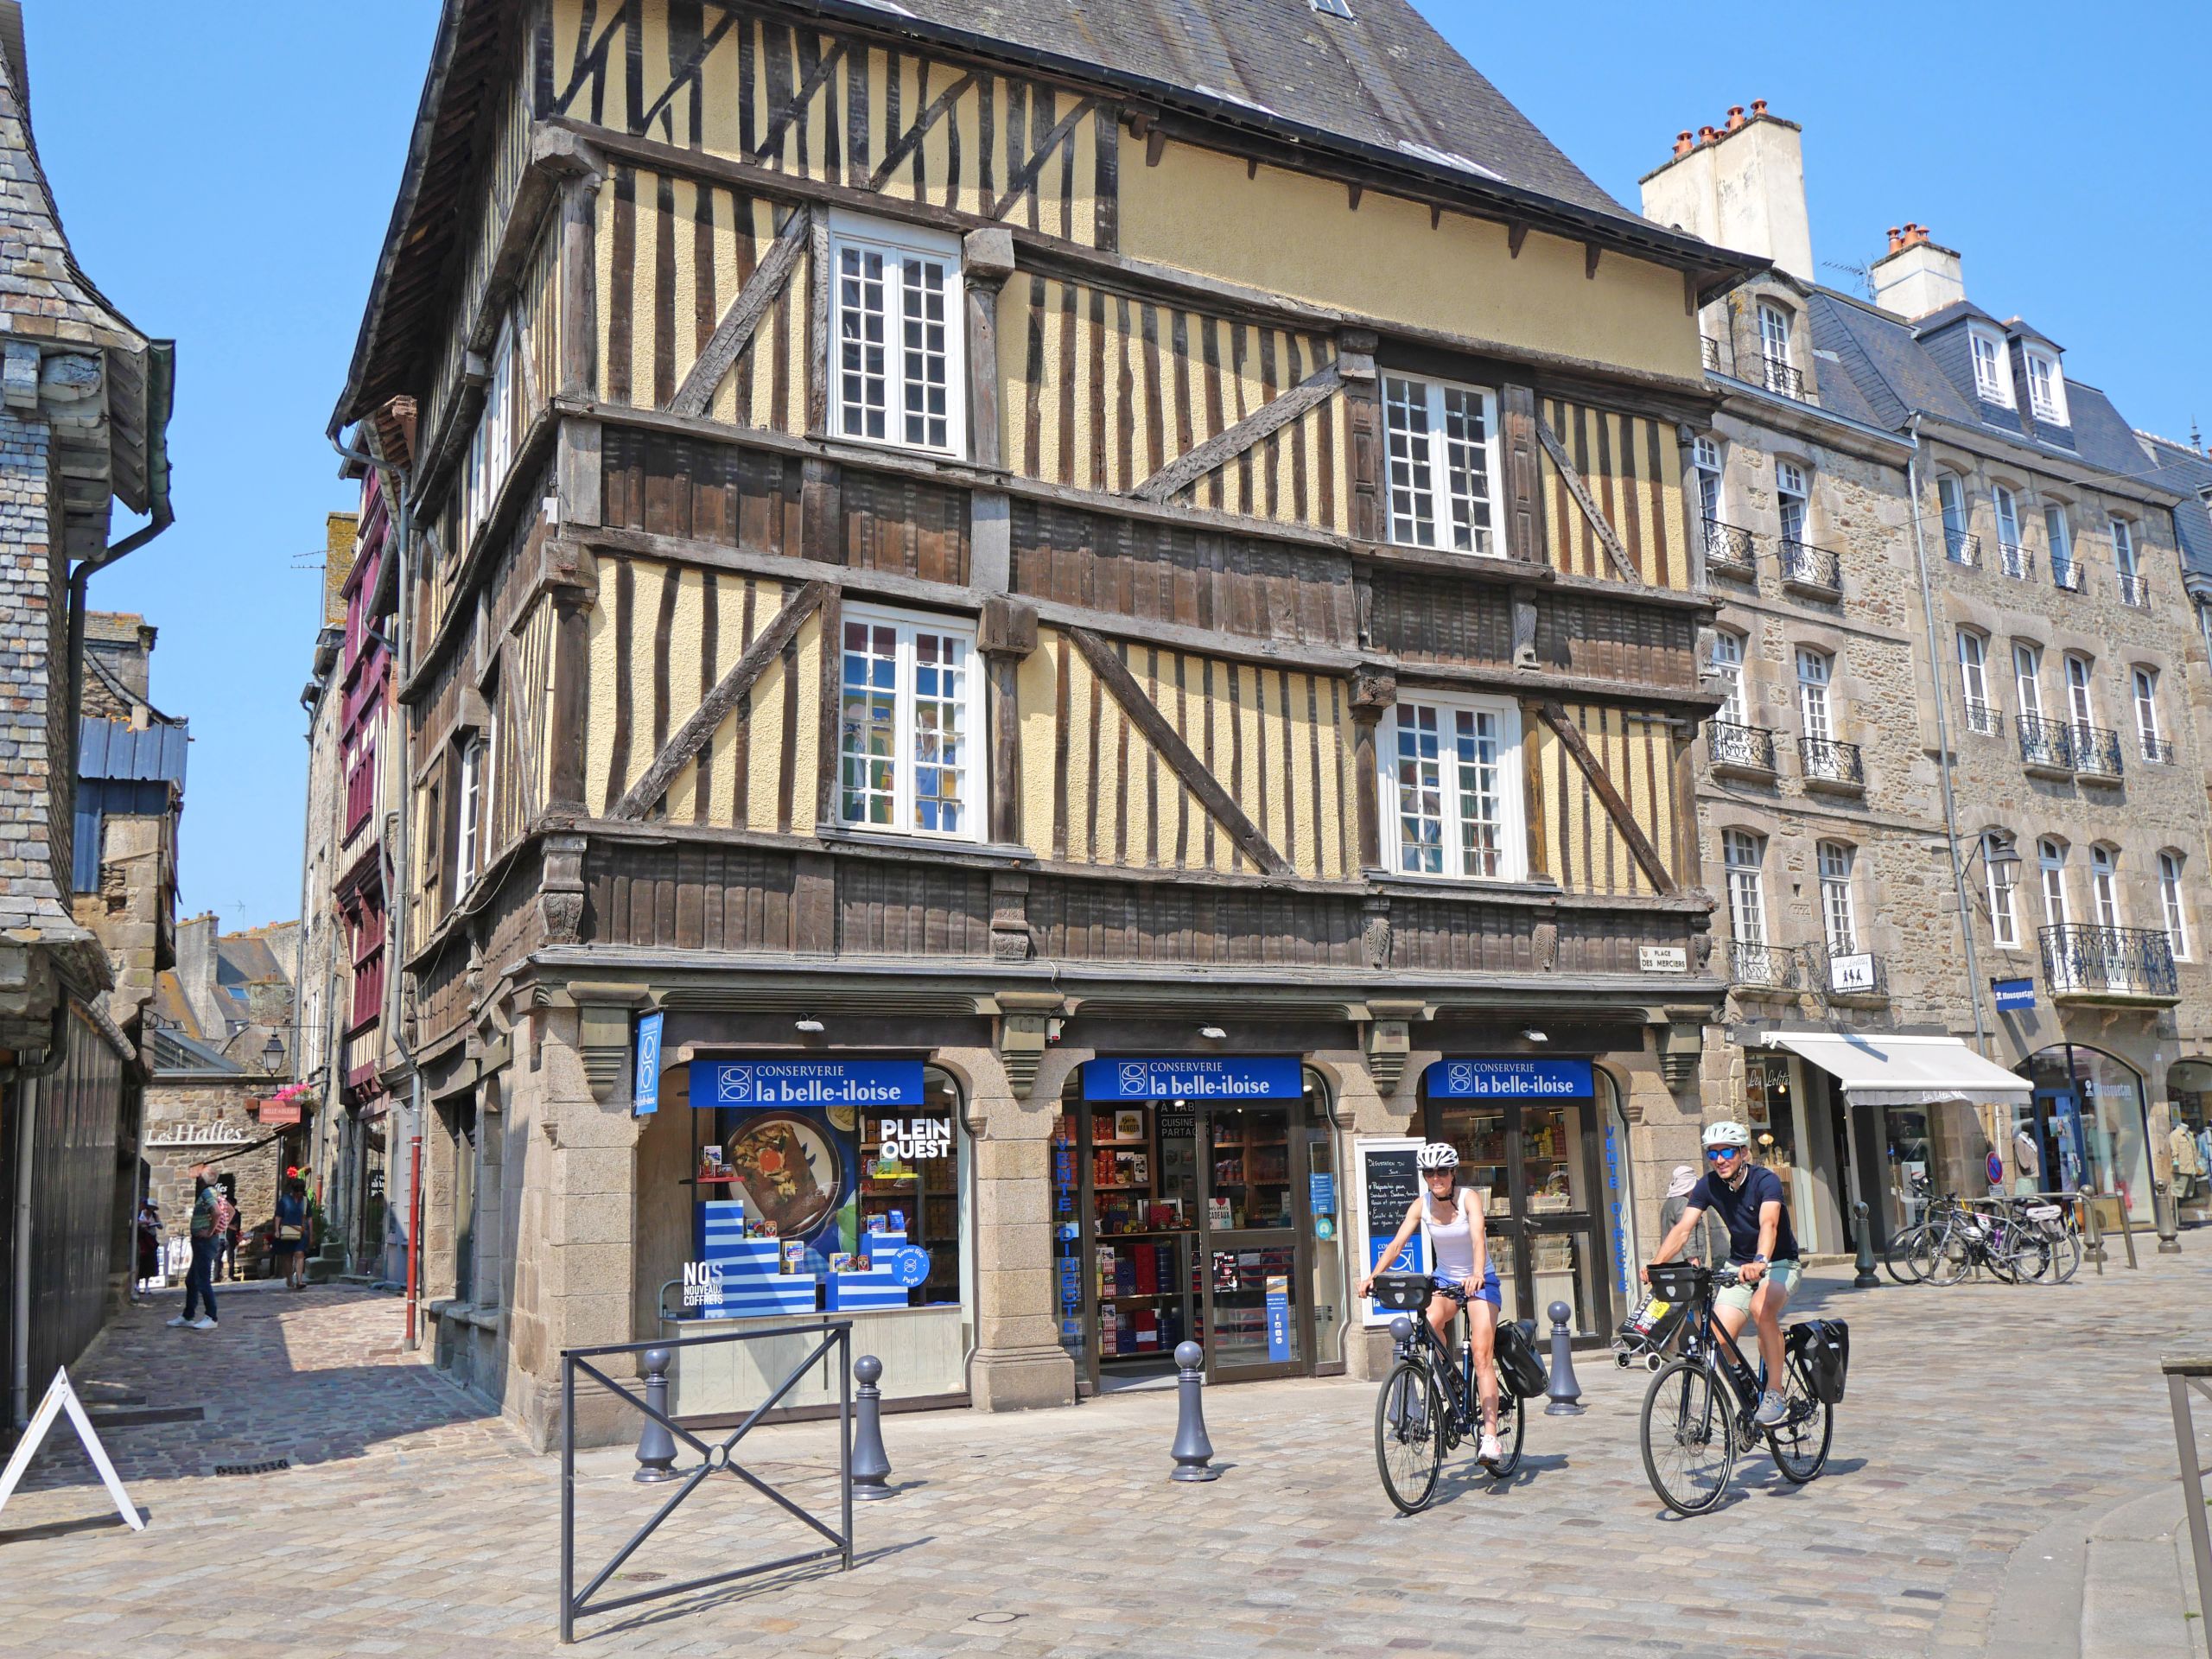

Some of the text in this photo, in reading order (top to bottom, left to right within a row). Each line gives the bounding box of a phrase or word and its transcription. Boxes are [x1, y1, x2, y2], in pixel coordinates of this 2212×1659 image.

[2002, 990, 2034, 1001] Mousqueton
[756, 1065, 844, 1077] CONSERVERIE
[1150, 1062, 1223, 1072] CONSERVERIE
[1474, 1063, 1535, 1072] CONSERVERIE
[1150, 1075, 1269, 1095] la belle-iloise
[1474, 1075, 1573, 1093] la belle-iloise
[1747, 1070, 1762, 1090] Les
[756, 1079, 901, 1102] la belle-iloise
[148, 1120, 244, 1141] Les Halles
[881, 1118, 950, 1141] PLEIN
[1161, 1118, 1196, 1127] CUISINE
[881, 1140, 950, 1159] OUEST
[1605, 1125, 1619, 1189] VENTE
[683, 1262, 723, 1286] NOS
[683, 1285, 723, 1295] NOUVEAUX
[683, 1294, 723, 1306] COFFRETS
[1373, 1298, 1381, 1306] la
